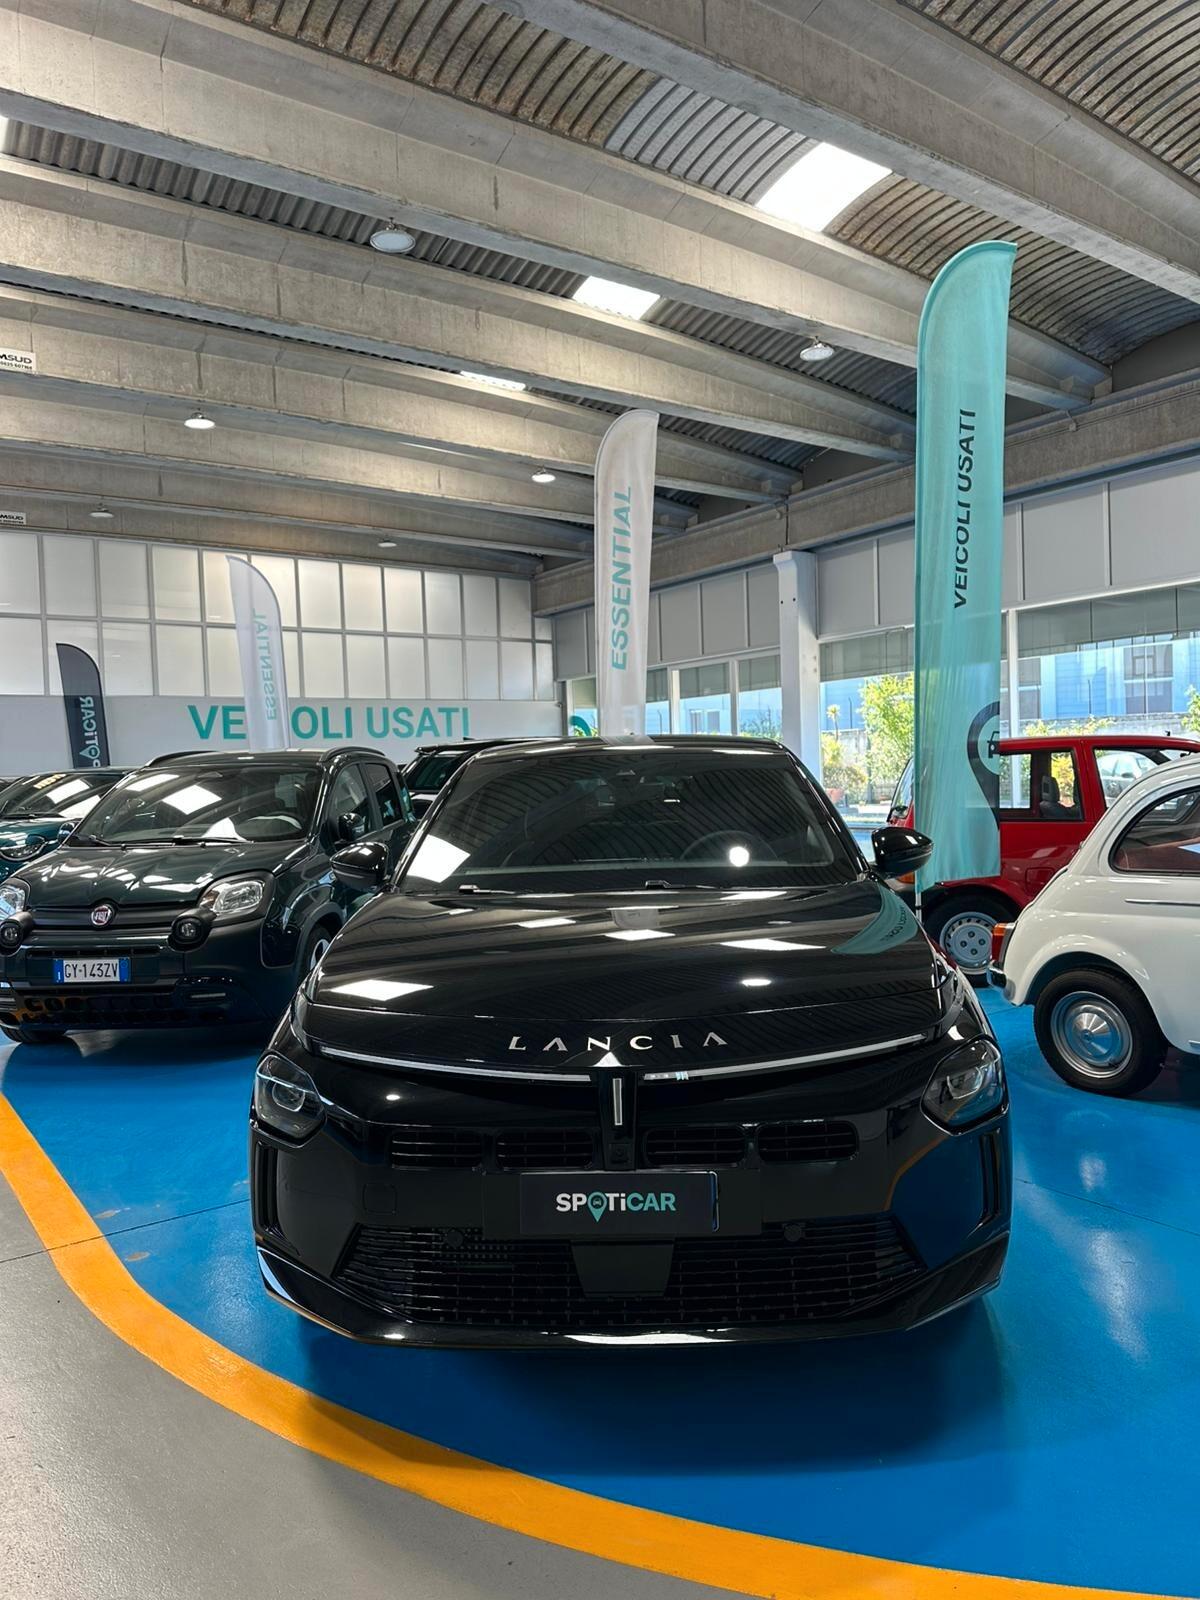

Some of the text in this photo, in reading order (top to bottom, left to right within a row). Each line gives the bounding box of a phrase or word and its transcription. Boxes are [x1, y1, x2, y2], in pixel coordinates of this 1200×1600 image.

[954, 408, 976, 609] VEICOLI USATI
[611, 486, 632, 671] ESSENTIAL
[187, 705, 470, 740] VEOLI USATI
[507, 1031, 729, 1052] LANCIA
